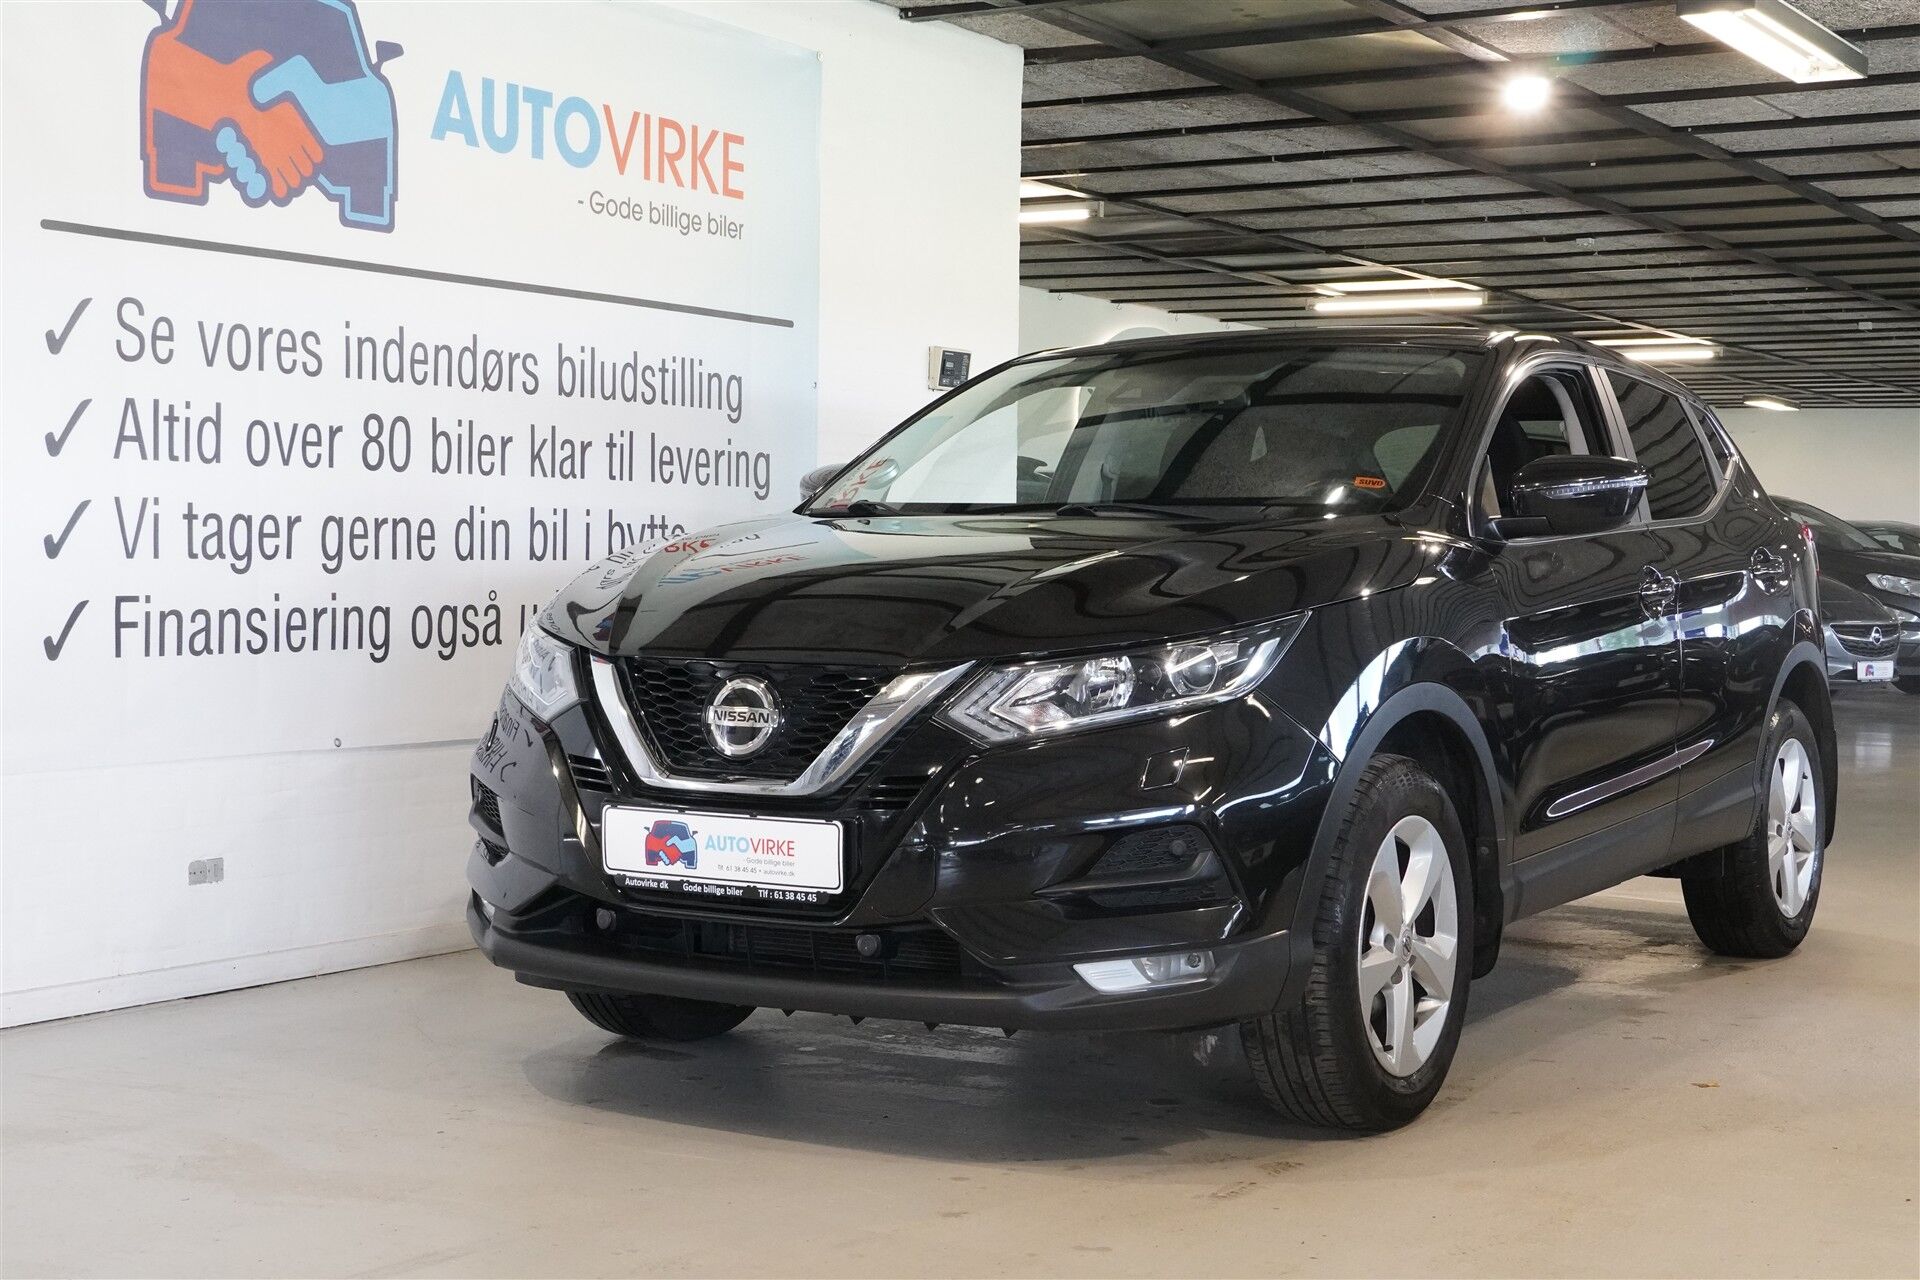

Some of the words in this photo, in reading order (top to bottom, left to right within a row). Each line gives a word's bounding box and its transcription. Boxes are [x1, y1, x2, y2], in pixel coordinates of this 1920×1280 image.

[430, 70, 745, 201] AUTOVIRKE
[589, 190, 643, 222] Gode
[648, 201, 702, 236] billige
[707, 212, 744, 240] biler
[115, 297, 175, 365] Se
[197, 320, 324, 378] vores
[343, 322, 541, 396] indendørs
[556, 342, 744, 425] biludstilling
[112, 397, 223, 465] Altid
[245, 419, 344, 470] over
[361, 412, 413, 474] 80
[430, 416, 514, 478] biler
[528, 423, 594, 481] klar
[605, 430, 635, 483] til
[649, 431, 771, 501] levering
[113, 496, 161, 560] Vi
[181, 500, 303, 577] tager
[320, 513, 437, 577] gerne
[454, 504, 511, 562] din
[527, 506, 569, 563] bil
[584, 507, 592, 562] i
[114, 594, 392, 664] Finansiering
[410, 588, 504, 662] også
[712, 708, 771, 724] NISSAN
[704, 834, 795, 857] AUTOVIRKE
[682, 882, 702, 893] Gode
[703, 884, 725, 896] billige
[726, 887, 743, 896] biler
[773, 890, 784, 899] 61
[784, 891, 795, 901] 38
[795, 893, 806, 902] 45
[806, 893, 818, 903] 45
